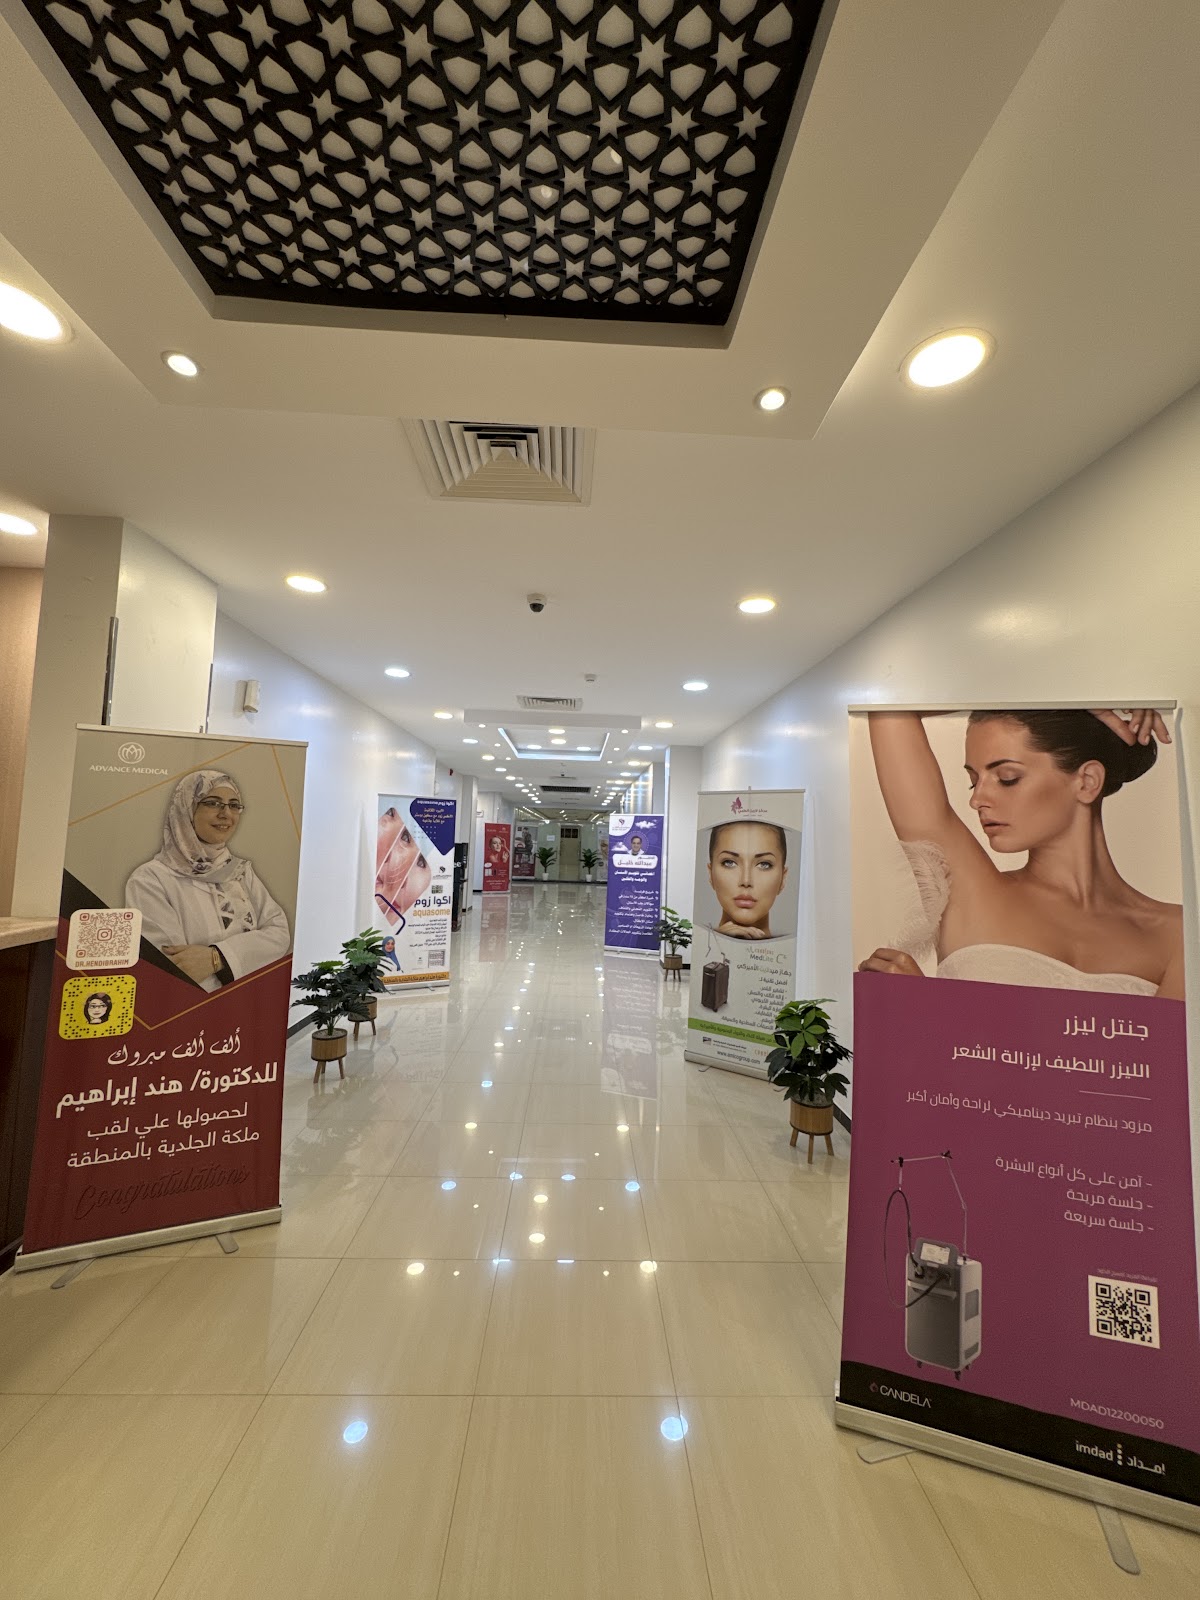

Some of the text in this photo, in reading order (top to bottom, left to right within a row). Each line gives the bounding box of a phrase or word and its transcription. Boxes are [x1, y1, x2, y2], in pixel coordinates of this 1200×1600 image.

[89, 765, 168, 775] ADVANCE MEDICAL
[412, 908, 451, 918] aquasome
[414, 896, 451, 908] اكوا زوم
[750, 954, 774, 962] MedLite
[779, 969, 792, 977] جهاز
[1063, 1015, 1149, 1041] جنتل ليزر
[107, 1026, 241, 1066] ألف ألف مبروك
[952, 1043, 1150, 1080] الليزر اللطيف لإزالة الشعر
[55, 1077, 138, 1118] إبراهيم
[144, 1075, 183, 1097] هند
[177, 1101, 248, 1129] لحصولها
[906, 1089, 1152, 1134] مزود بنظام تبريد ديناميكي لراحة وأمان أكبر
[87, 1117, 129, 1140] لقب
[66, 1127, 260, 1168] ملكة الجلدية بالمنطقة
[995, 1156, 1142, 1189] آمن على كل أنواع البشرة
[1066, 1188, 1143, 1211] جلسة مريحة
[1063, 1210, 1144, 1234] جلسة سريعة
[880, 1385, 932, 1408] CANDELA
[1070, 1398, 1164, 1429] MDAD12200050
[1075, 1440, 1114, 1461] imdad
[1126, 1455, 1166, 1476] إمداد
